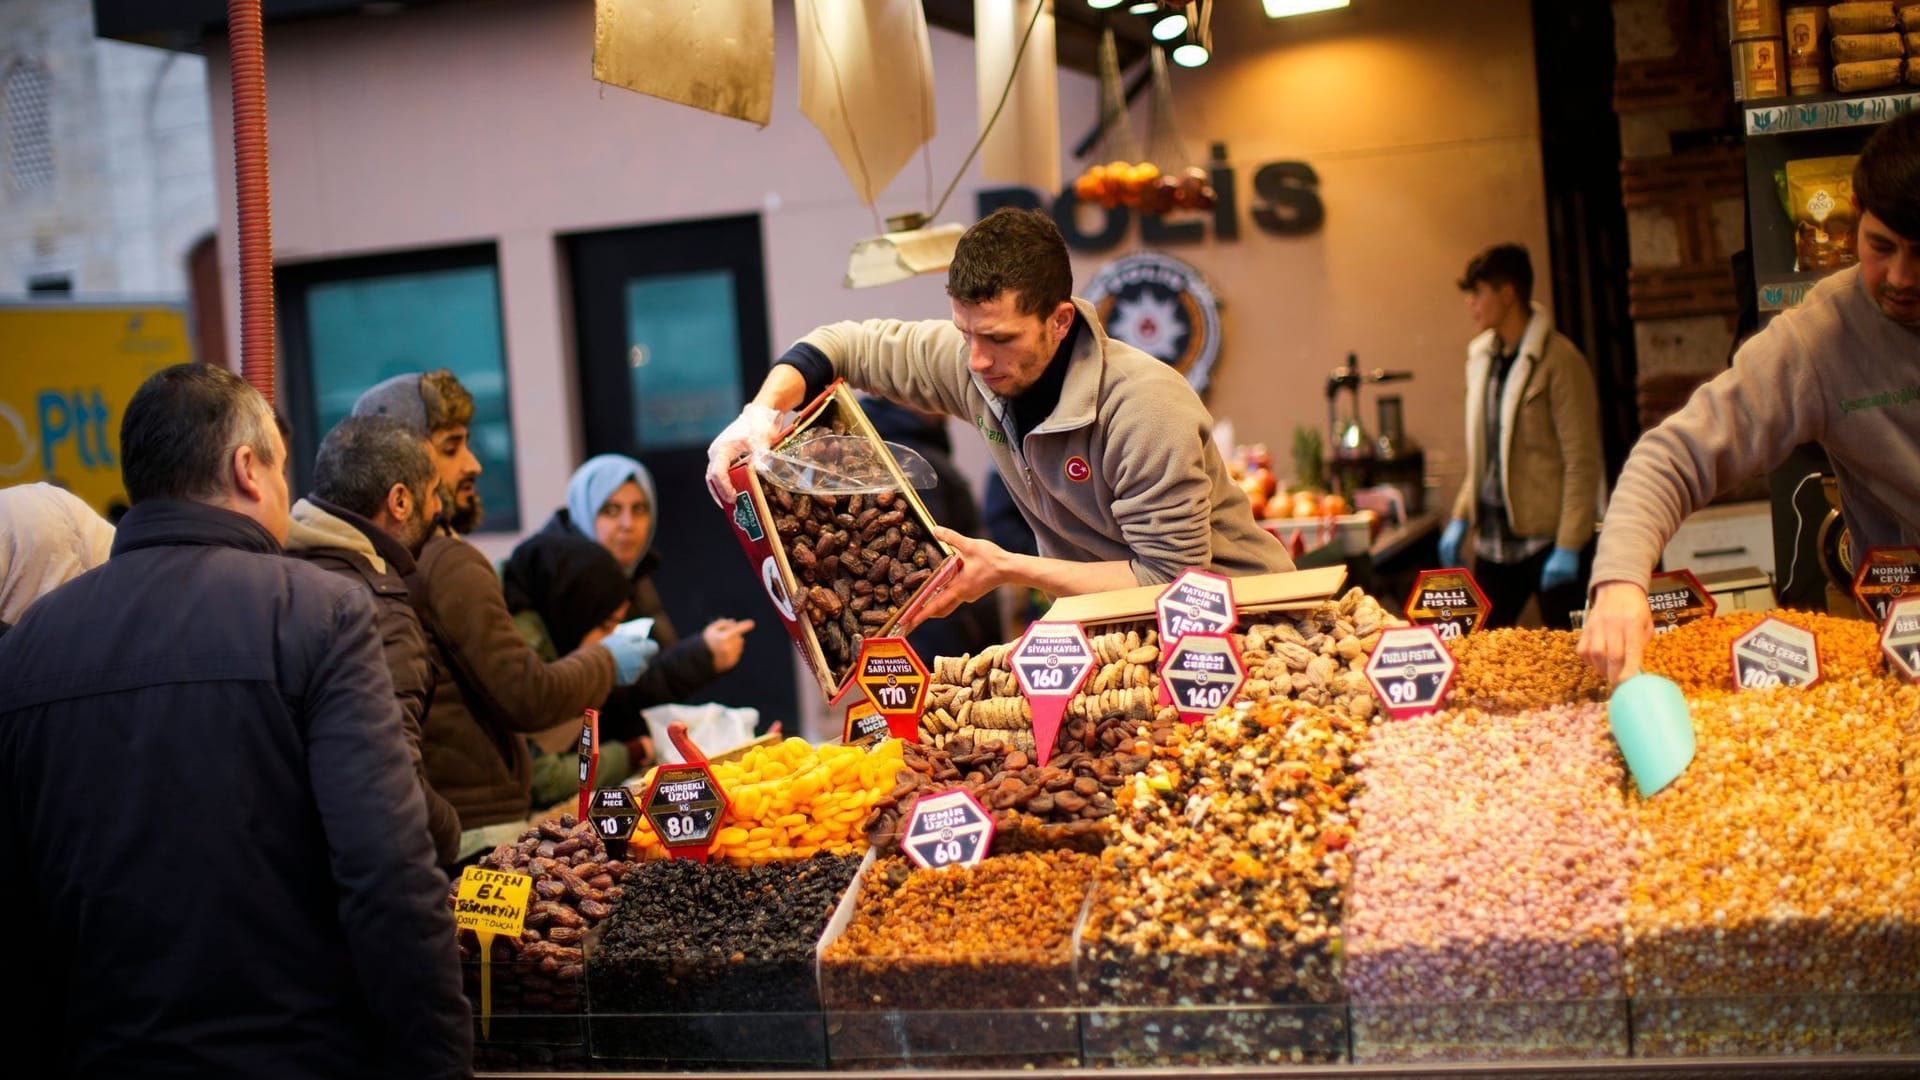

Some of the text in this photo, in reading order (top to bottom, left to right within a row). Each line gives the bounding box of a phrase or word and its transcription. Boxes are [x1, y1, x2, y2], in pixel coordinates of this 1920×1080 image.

[1872, 567, 1916, 576] NORMAL
[1880, 575, 1911, 583] CEVİZ
[1180, 586, 1222, 602] NATURAL
[1424, 591, 1465, 600] BALLI
[1647, 591, 1689, 604] SOSLU
[1185, 594, 1211, 609] İNCİR
[1422, 599, 1468, 607] FISTIK
[1651, 600, 1688, 611] MISIR
[1027, 644, 1051, 653] SİYAH
[1381, 648, 1436, 664] TUZLU FISTIK
[867, 665, 886, 673] SARI
[1031, 669, 1063, 687] 160
[879, 687, 907, 705] 170
[1187, 687, 1221, 708] 140
[1389, 681, 1417, 703] 90
[660, 781, 705, 794] ÇEKİRDEKLİ
[668, 791, 699, 801] ÜZÜM
[601, 817, 617, 834] 10
[668, 816, 694, 836] 80
[924, 816, 966, 830] ÜZÜM
[935, 840, 962, 864] 60
[476, 883, 506, 901] EL
